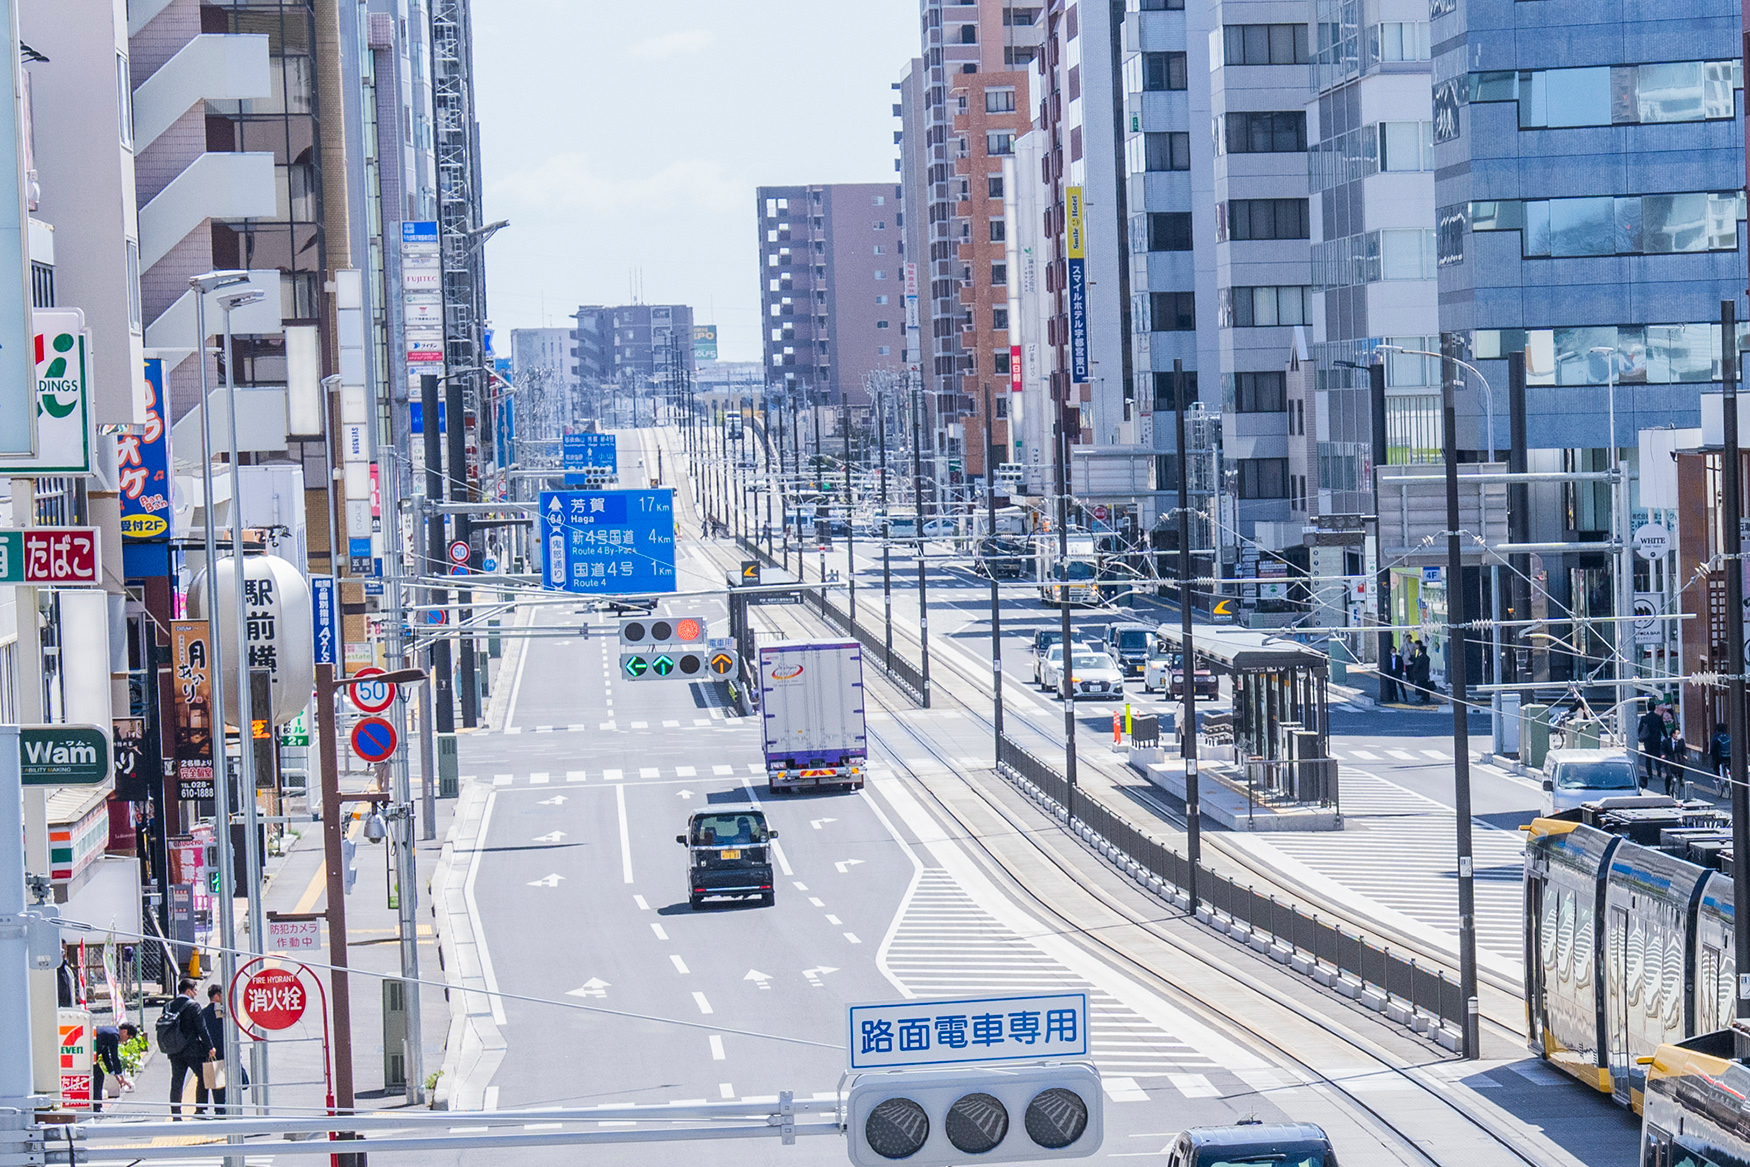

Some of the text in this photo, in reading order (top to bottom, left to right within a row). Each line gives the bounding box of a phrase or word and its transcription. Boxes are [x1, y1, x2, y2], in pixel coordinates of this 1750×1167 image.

[407, 275, 437, 284] FUJITEC
[1072, 265, 1085, 376] スマイルホテル宇都宮東口
[38, 379, 78, 392] DINGS
[351, 426, 360, 455] SVENSON
[571, 497, 606, 514] 芳賀
[638, 496, 670, 512] 17 Km
[550, 514, 562, 524] 64
[570, 515, 595, 525] Haga
[121, 520, 164, 532] 受付2F
[572, 529, 635, 545] 新4号国道
[648, 528, 671, 544] 4 Km
[1640, 537, 1666, 545] WHITE
[27, 534, 93, 579] たばこ
[454, 547, 466, 557] 50
[572, 547, 595, 556] Route
[552, 539, 563, 579] 鬼怒通り
[573, 560, 634, 578] 国道4号
[650, 559, 672, 576] 1 Km
[1425, 571, 1437, 580] 4F
[573, 578, 607, 588] Route 4
[245, 578, 279, 683] 駅前横
[708, 638, 733, 648] 電車用
[1159, 644, 1167, 653] 2
[360, 680, 385, 701] 50
[287, 737, 304, 746] 2F
[25, 741, 97, 764] Wam
[270, 923, 317, 935] 防犯カメラ
[276, 937, 313, 948] 作動中
[252, 975, 295, 985] FIRE HYDRANT
[248, 985, 302, 1013] 消火栓
[861, 1008, 1078, 1055] 路面電車専用
